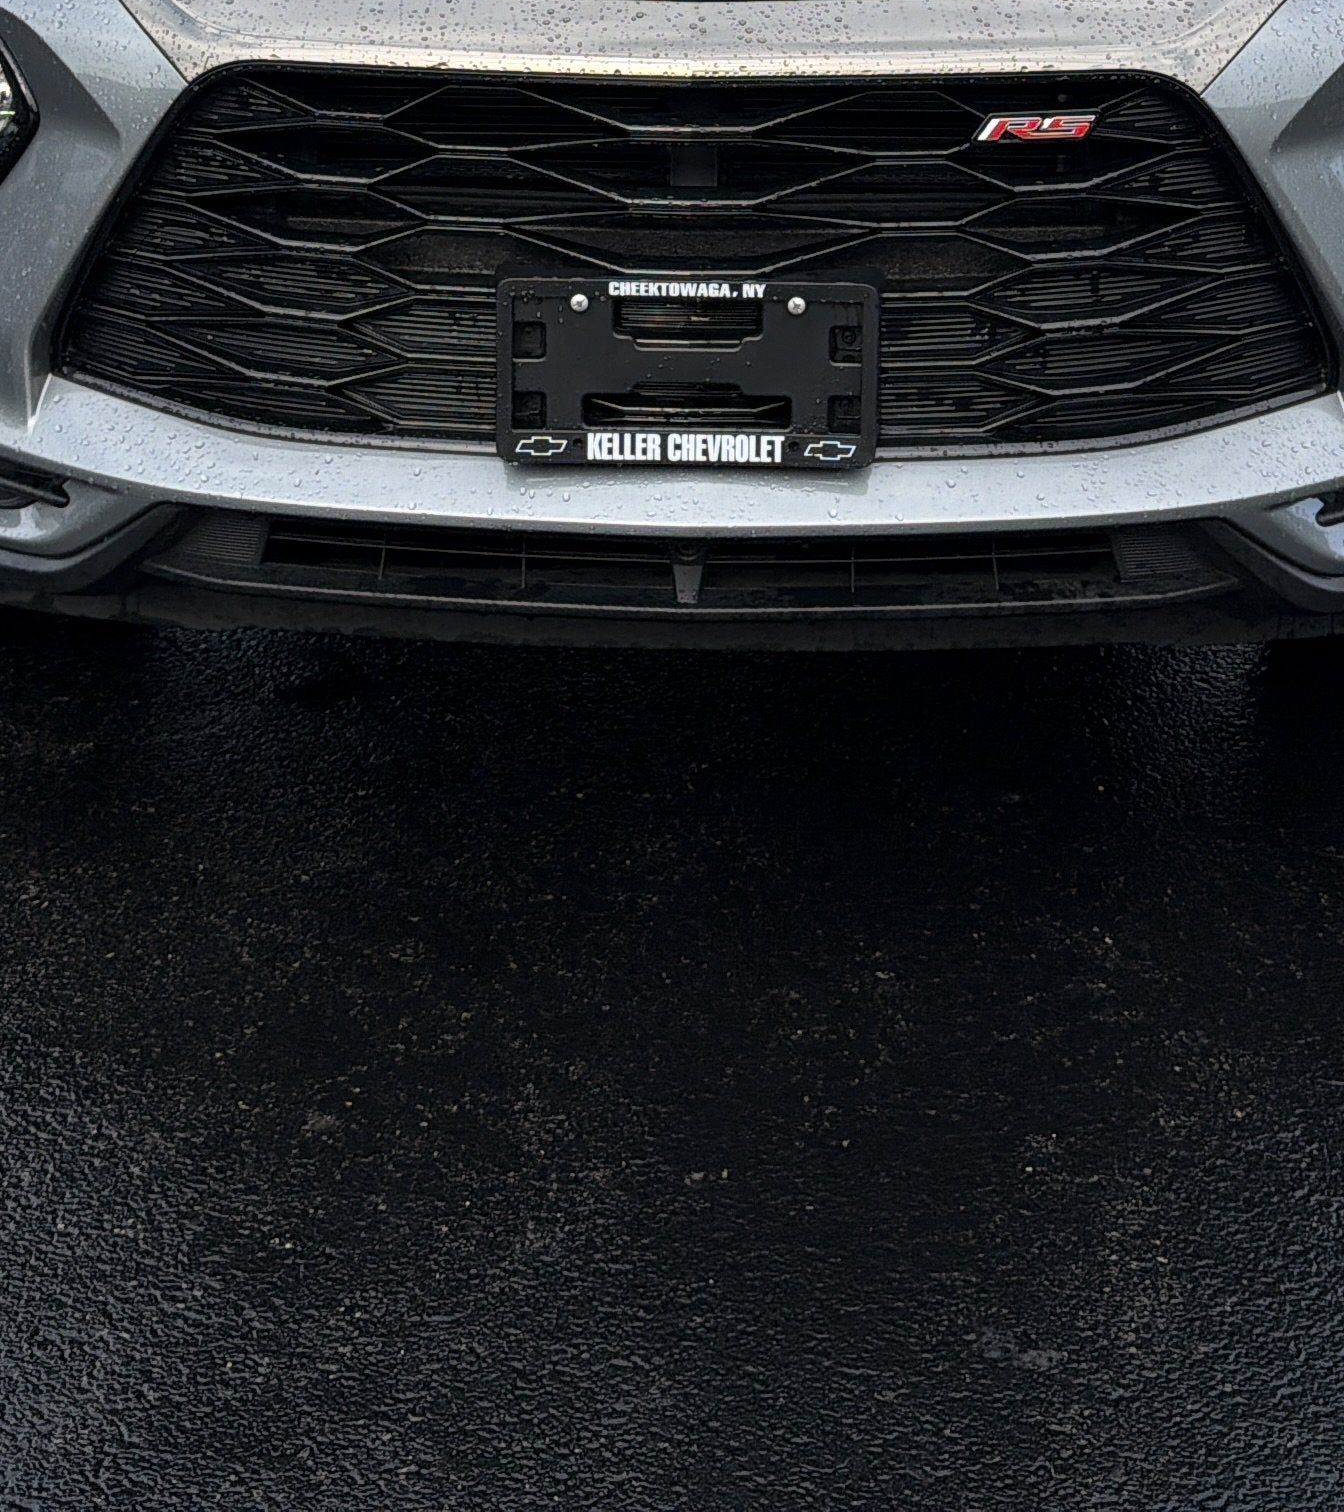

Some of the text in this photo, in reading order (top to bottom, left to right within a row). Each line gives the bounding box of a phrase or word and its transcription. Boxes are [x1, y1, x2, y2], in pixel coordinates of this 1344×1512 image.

[977, 115, 1096, 141] RS
[608, 281, 766, 298] CHEEKTOWAGA, NY
[587, 432, 785, 463] KELLER CHEVROLET
